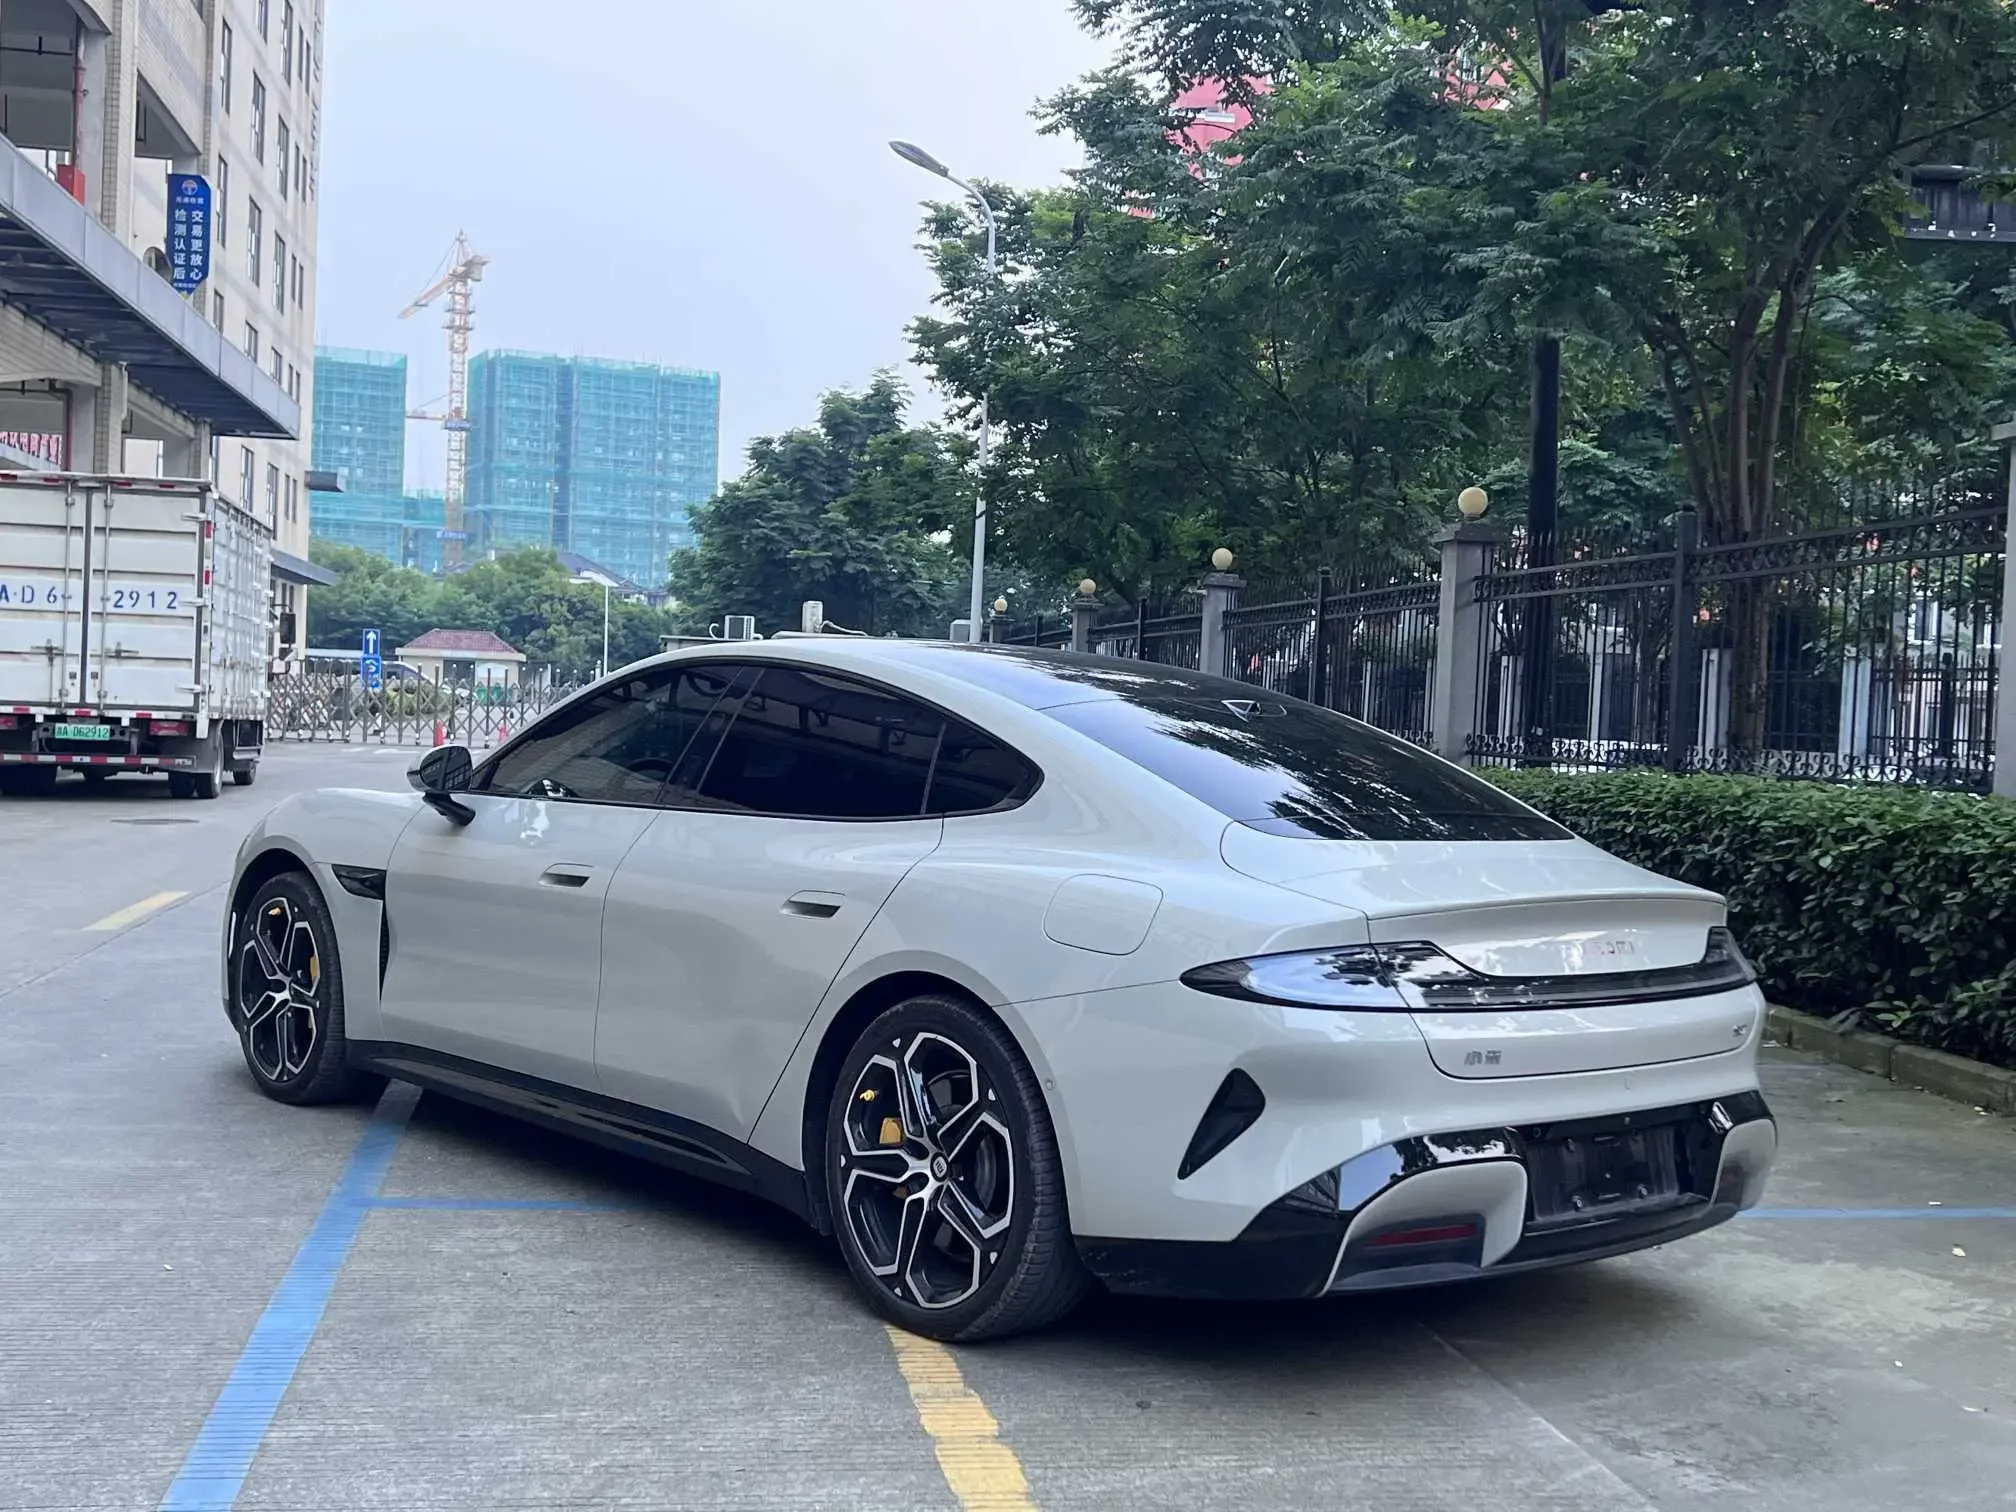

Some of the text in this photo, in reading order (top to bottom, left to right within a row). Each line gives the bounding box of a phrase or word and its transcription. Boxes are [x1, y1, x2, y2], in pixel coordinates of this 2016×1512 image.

[173, 208, 187, 280] 检测认证后
[190, 210, 203, 281] 交易更放心
[113, 590, 178, 609] 2912
